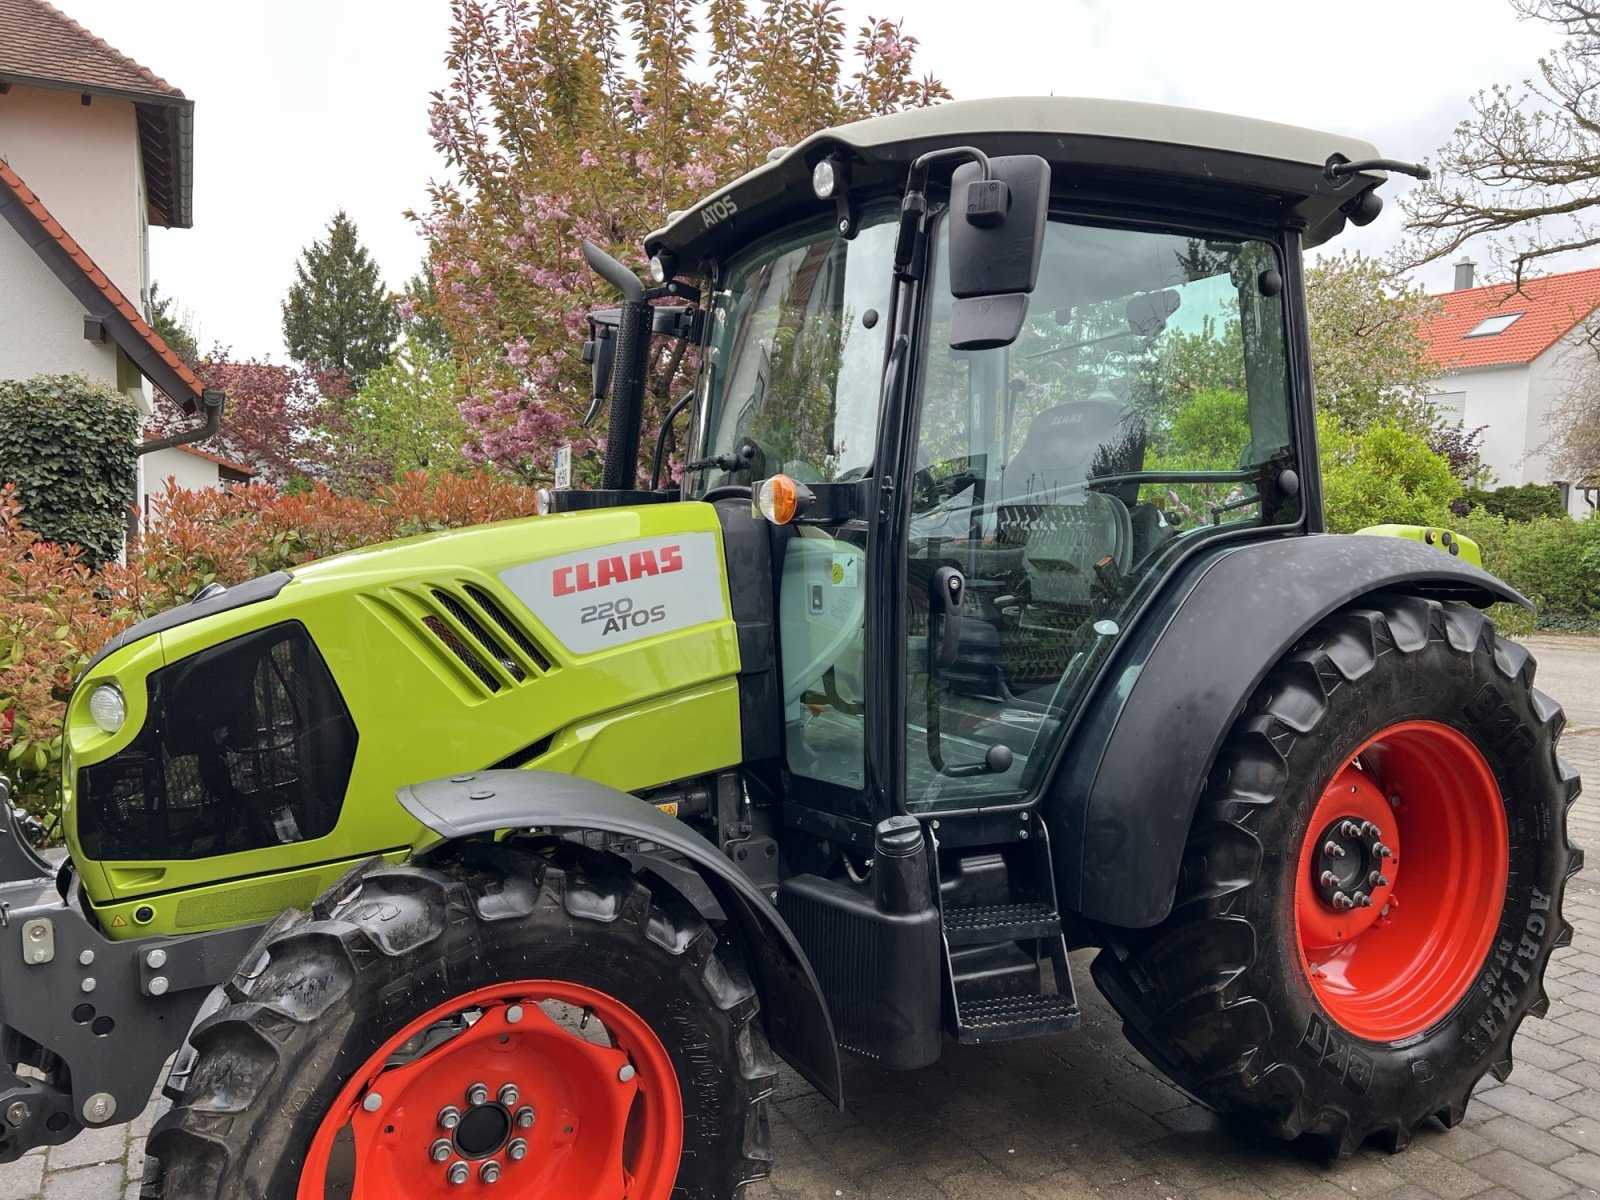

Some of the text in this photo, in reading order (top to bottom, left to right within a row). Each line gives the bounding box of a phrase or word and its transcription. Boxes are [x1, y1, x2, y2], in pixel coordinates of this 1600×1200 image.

[700, 194, 738, 228] ATOS
[1050, 414, 1084, 426] CLAAS
[551, 545, 683, 597] CLAAS
[580, 597, 633, 624] 220
[601, 604, 666, 636] ATOS
